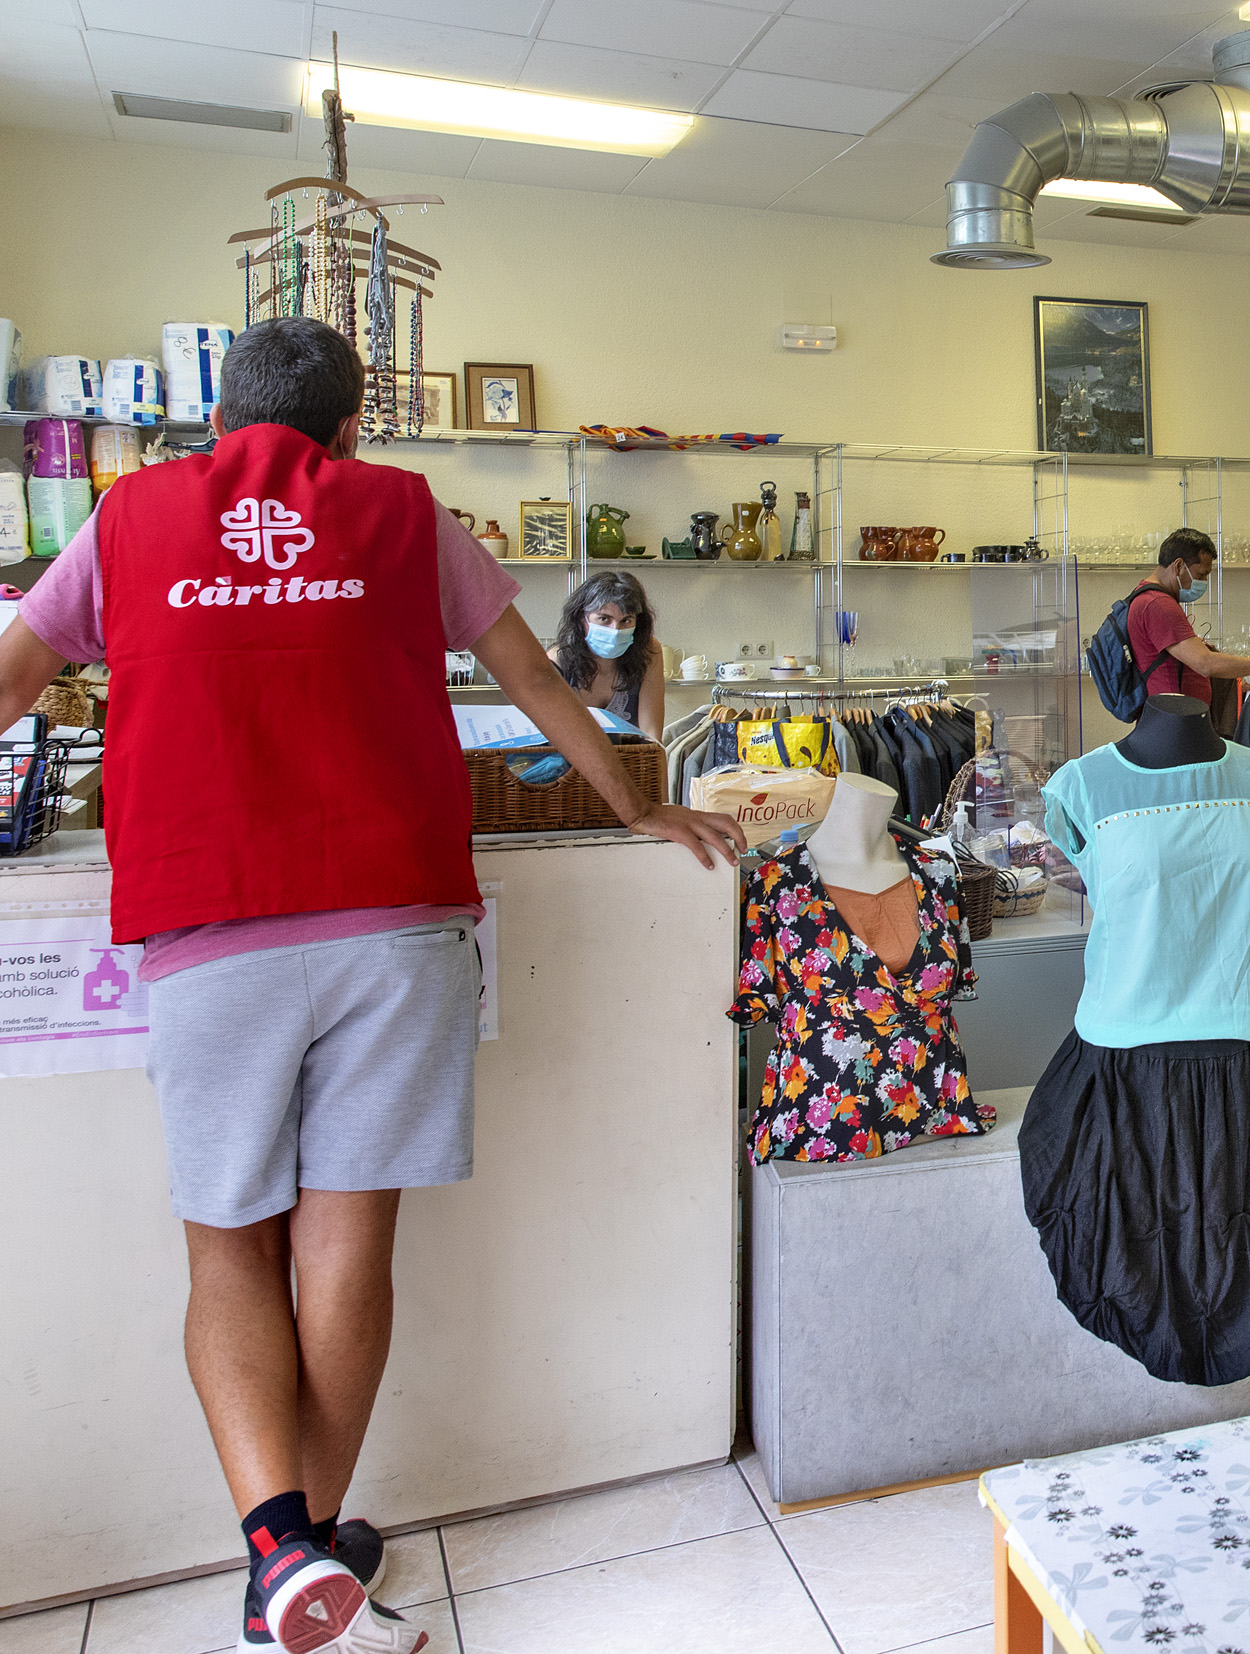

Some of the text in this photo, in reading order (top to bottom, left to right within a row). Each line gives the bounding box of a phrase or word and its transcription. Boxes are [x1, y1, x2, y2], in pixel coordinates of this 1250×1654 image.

[167, 576, 375, 609] Càritas
[736, 797, 816, 823] IncoPack
[0, 953, 61, 966] -vos les
[30, 966, 79, 980] solució
[23, 1016, 49, 1026] eficaç
